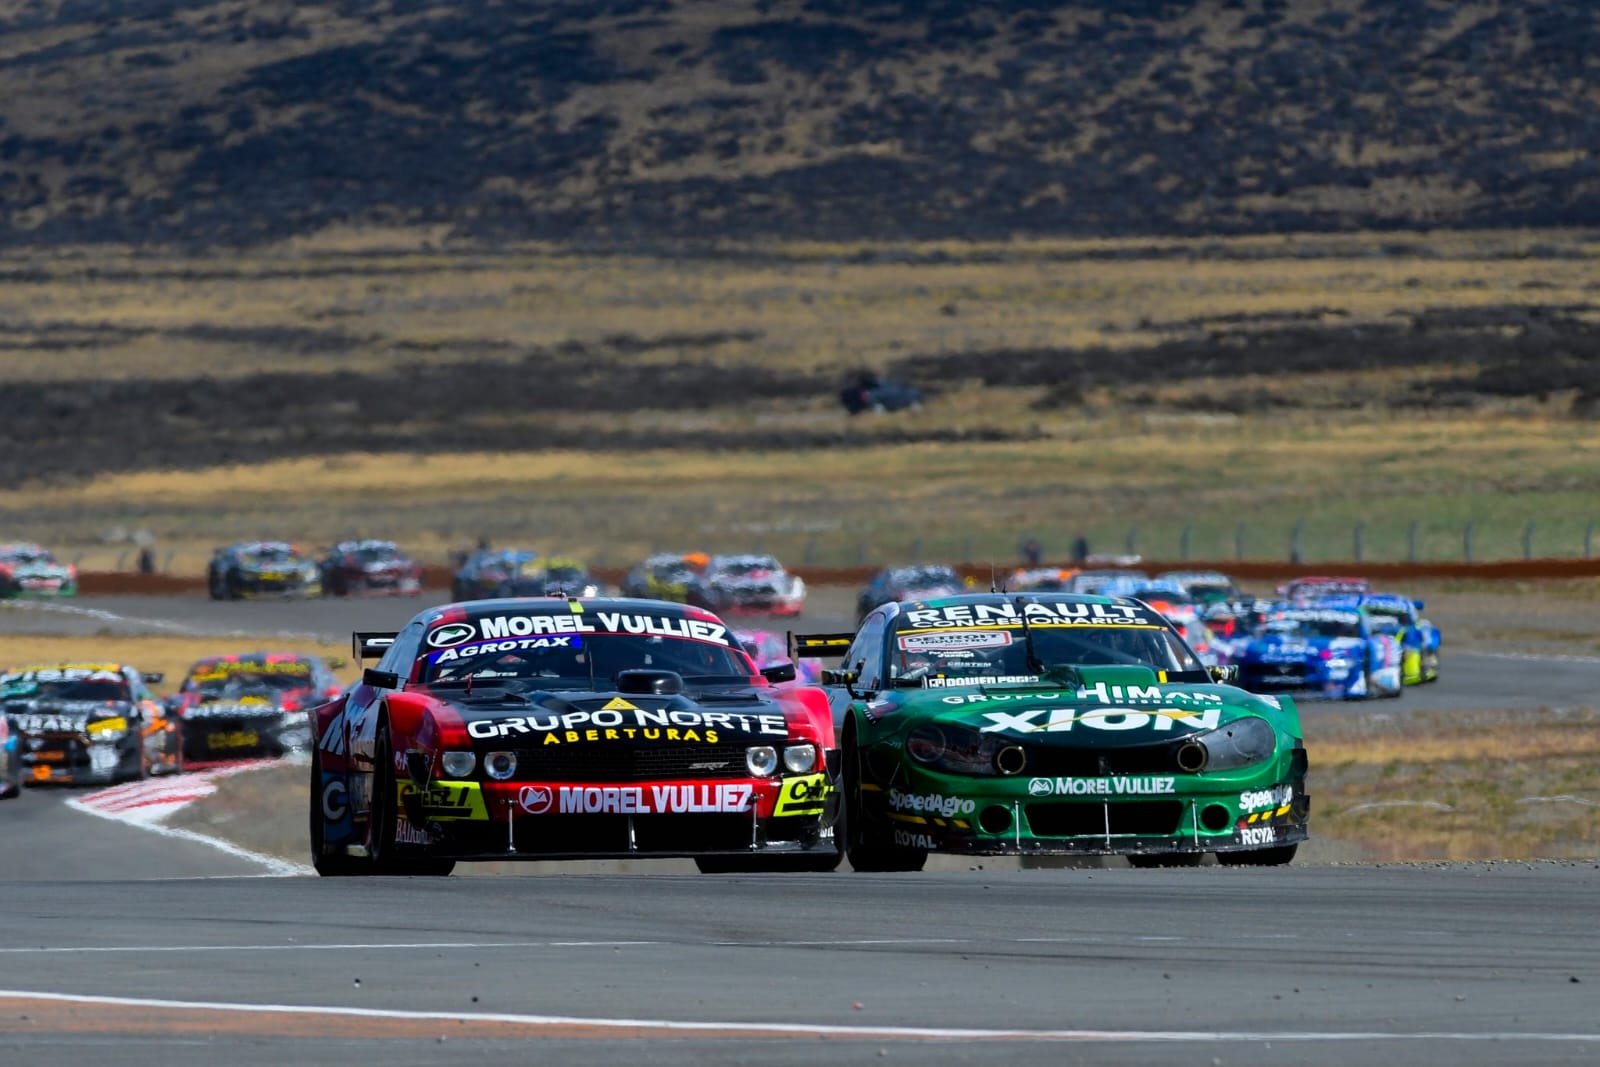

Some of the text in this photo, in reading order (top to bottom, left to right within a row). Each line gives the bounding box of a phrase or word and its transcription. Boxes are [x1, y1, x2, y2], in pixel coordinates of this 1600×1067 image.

[906, 603, 1143, 622] RENAULT
[912, 617, 1148, 628] CONCESIONARIOS
[480, 611, 729, 645] MOREL VULLIEZ
[908, 633, 998, 643] DETROIT
[435, 637, 570, 664] AGROTAX
[1077, 682, 1223, 704] HIMAN
[467, 708, 789, 739] GRUPO NORTE
[980, 708, 1222, 733] XION
[543, 727, 719, 746] ABERTURAS
[1055, 776, 1175, 795] MOREL VULLIEZ
[559, 784, 753, 814] MOREL VULLIEZ
[888, 788, 976, 817] SpeedAgro
[894, 830, 937, 849] ROYAL
